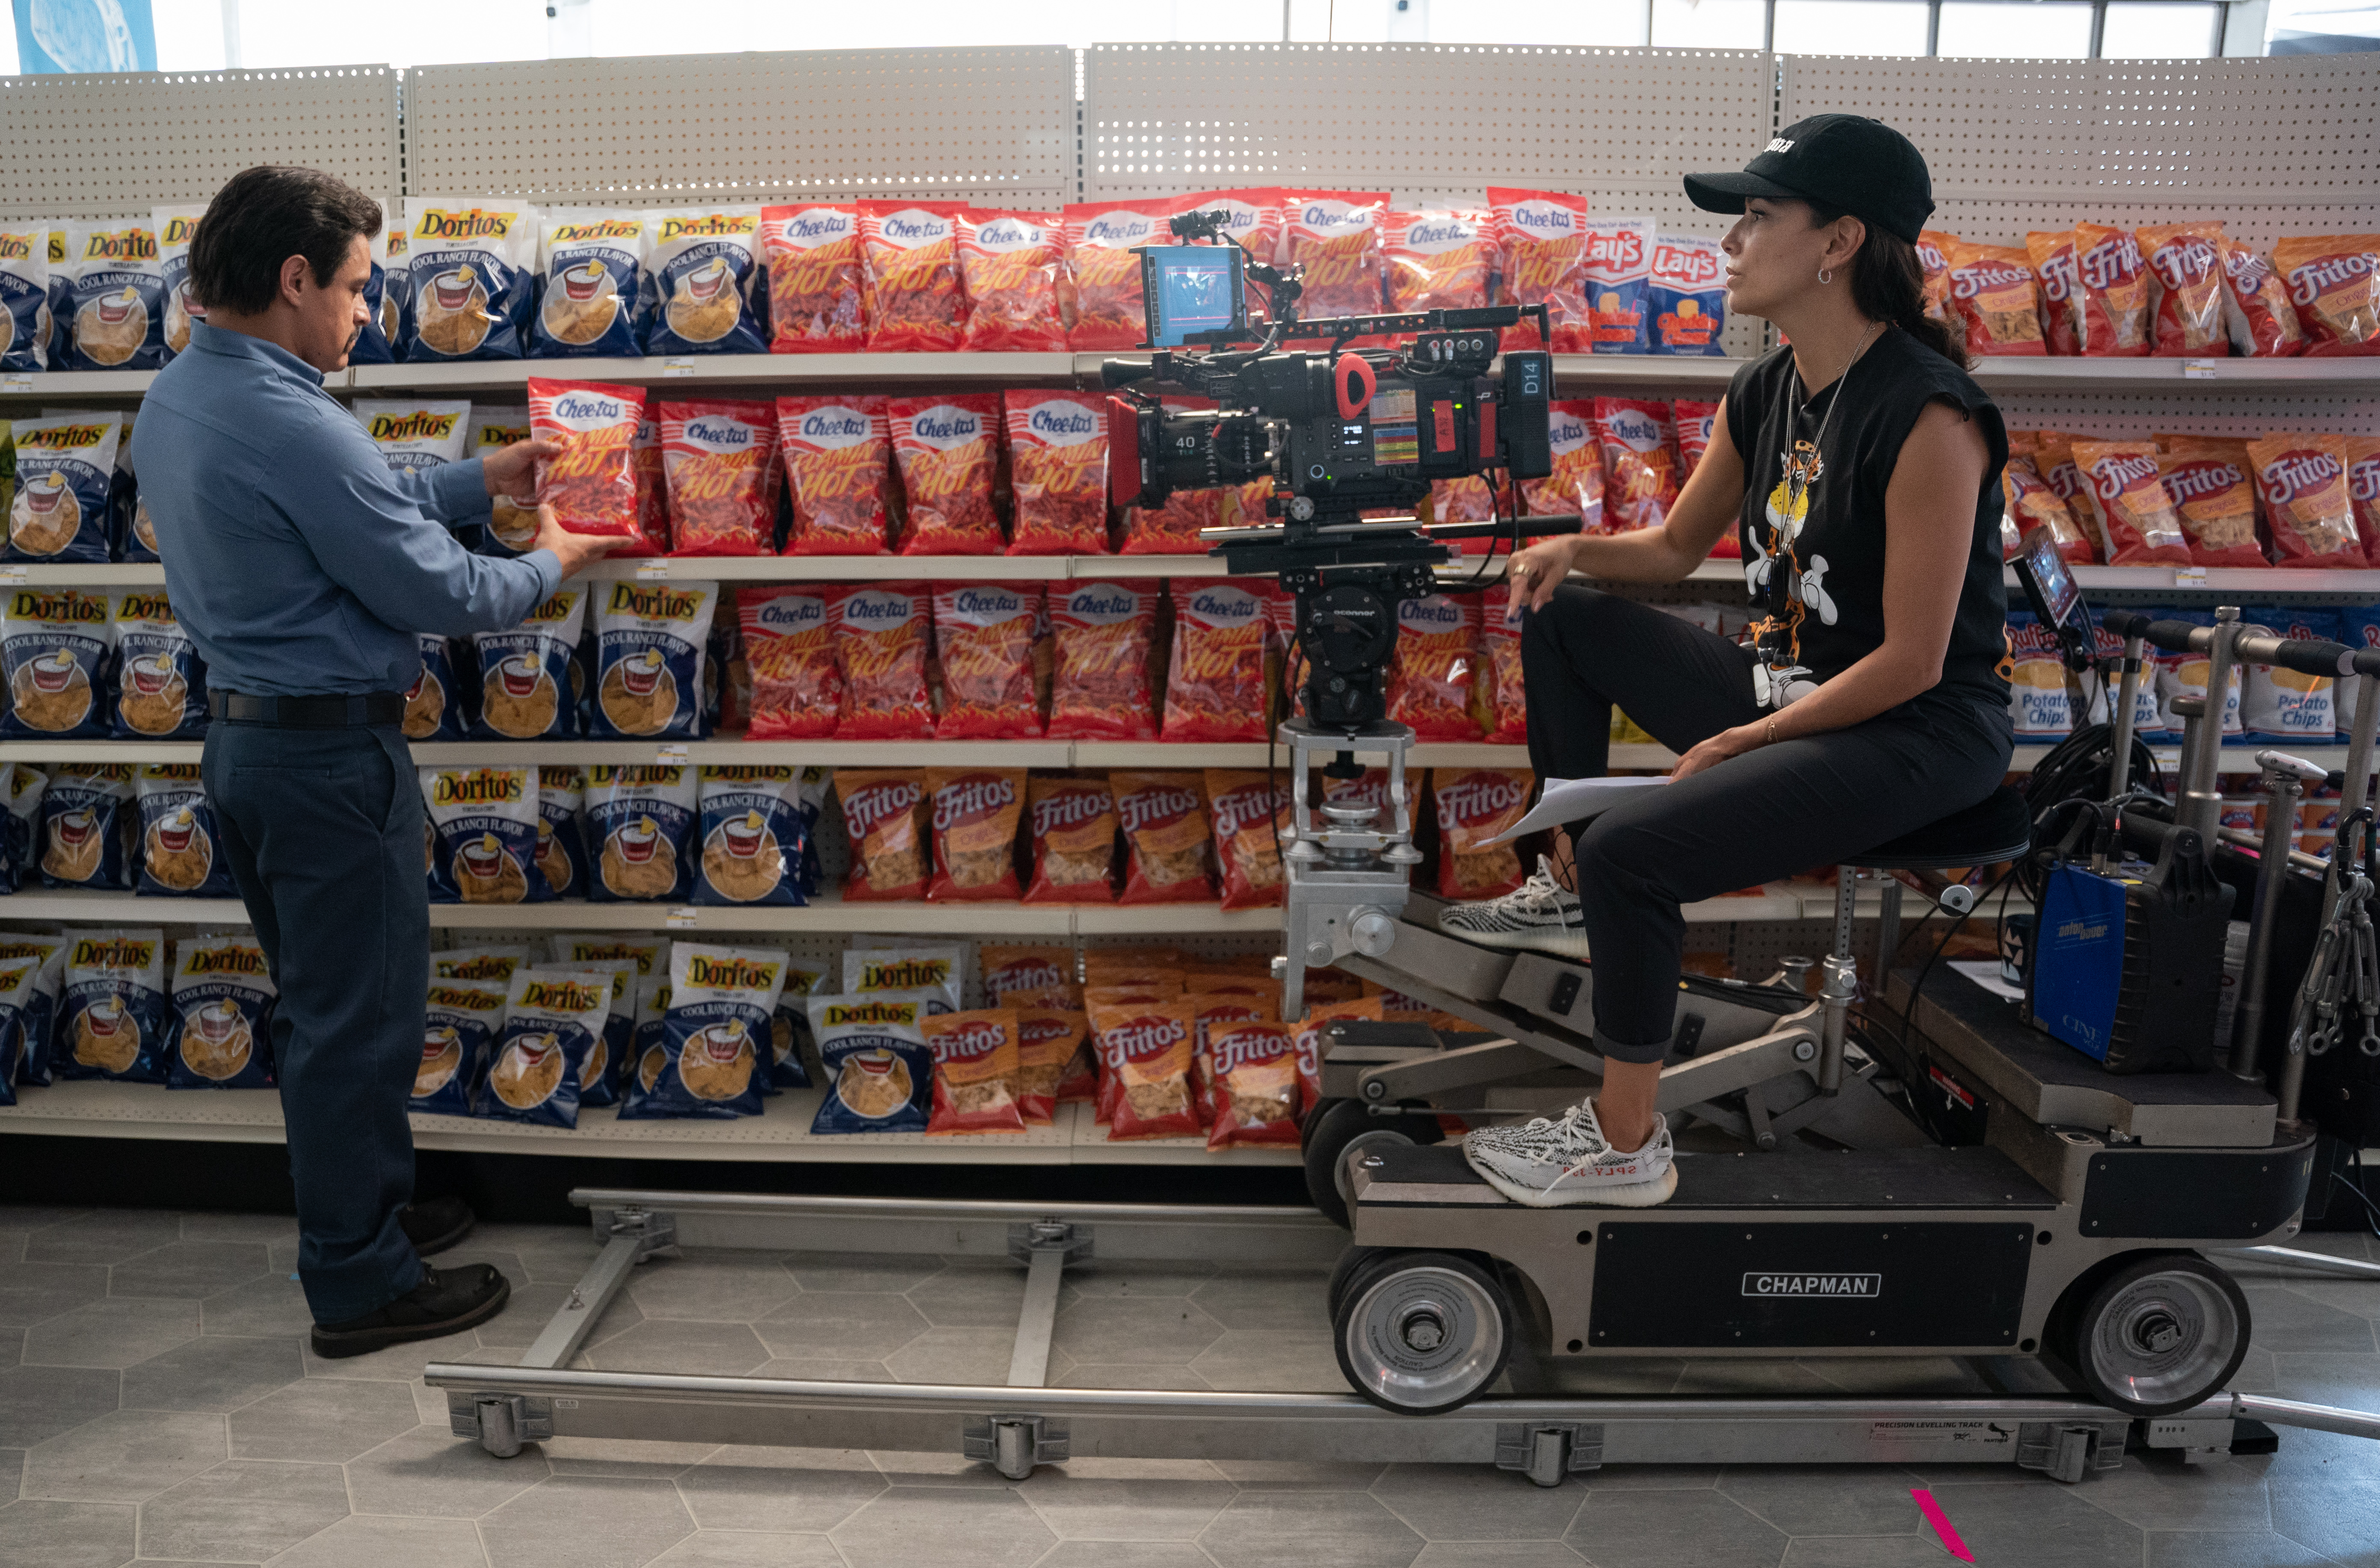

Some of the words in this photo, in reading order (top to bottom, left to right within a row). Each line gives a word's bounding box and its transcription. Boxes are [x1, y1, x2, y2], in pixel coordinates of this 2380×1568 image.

[422, 213, 508, 236] Doritos
[554, 222, 639, 241] Doritos
[663, 219, 752, 239] Doritos
[89, 232, 157, 257] Dorito
[598, 248, 634, 266] FLAVOR
[1590, 233, 1639, 270] ay's
[411, 257, 436, 271] COOL
[437, 252, 469, 263] RANCH
[1655, 249, 1714, 281] Lay's
[1951, 264, 2033, 300] Fritos
[2289, 253, 2380, 306] Fritos
[1524, 363, 1539, 395] D14
[18, 424, 104, 449] Doritos
[374, 413, 452, 440] Doritos
[1176, 435, 1195, 448] 40
[2092, 452, 2160, 500] Fritos
[2161, 462, 2244, 507] Fritos
[2263, 450, 2344, 504] Fritos
[15, 592, 106, 622] Doritos
[613, 583, 697, 618] Doritos
[2279, 695, 2327, 710] Potato
[2029, 708, 2065, 728] Chips
[2282, 710, 2322, 728] Chips
[438, 772, 521, 803] Doritos
[844, 781, 922, 840] Fritos
[933, 778, 1016, 831] Fritos
[1033, 788, 1112, 837] Fritos
[1118, 785, 1199, 830] Fritos
[1437, 780, 1525, 834] Fritos
[75, 941, 151, 969] Doritos
[192, 948, 268, 973] Doritos
[693, 956, 772, 986] Doritos
[864, 961, 948, 988] Doritos
[176, 987, 201, 1003] COOL
[202, 984, 229, 997] RANCH
[230, 985, 265, 1003] FLAVOR
[523, 981, 598, 1010] Doritos
[829, 1005, 915, 1024] Doritos
[930, 1023, 1006, 1062] Fritos
[1105, 1018, 1187, 1069] Fritos
[1213, 1031, 1292, 1075] Fritos
[1757, 1276, 1868, 1293] CHAPMAN
